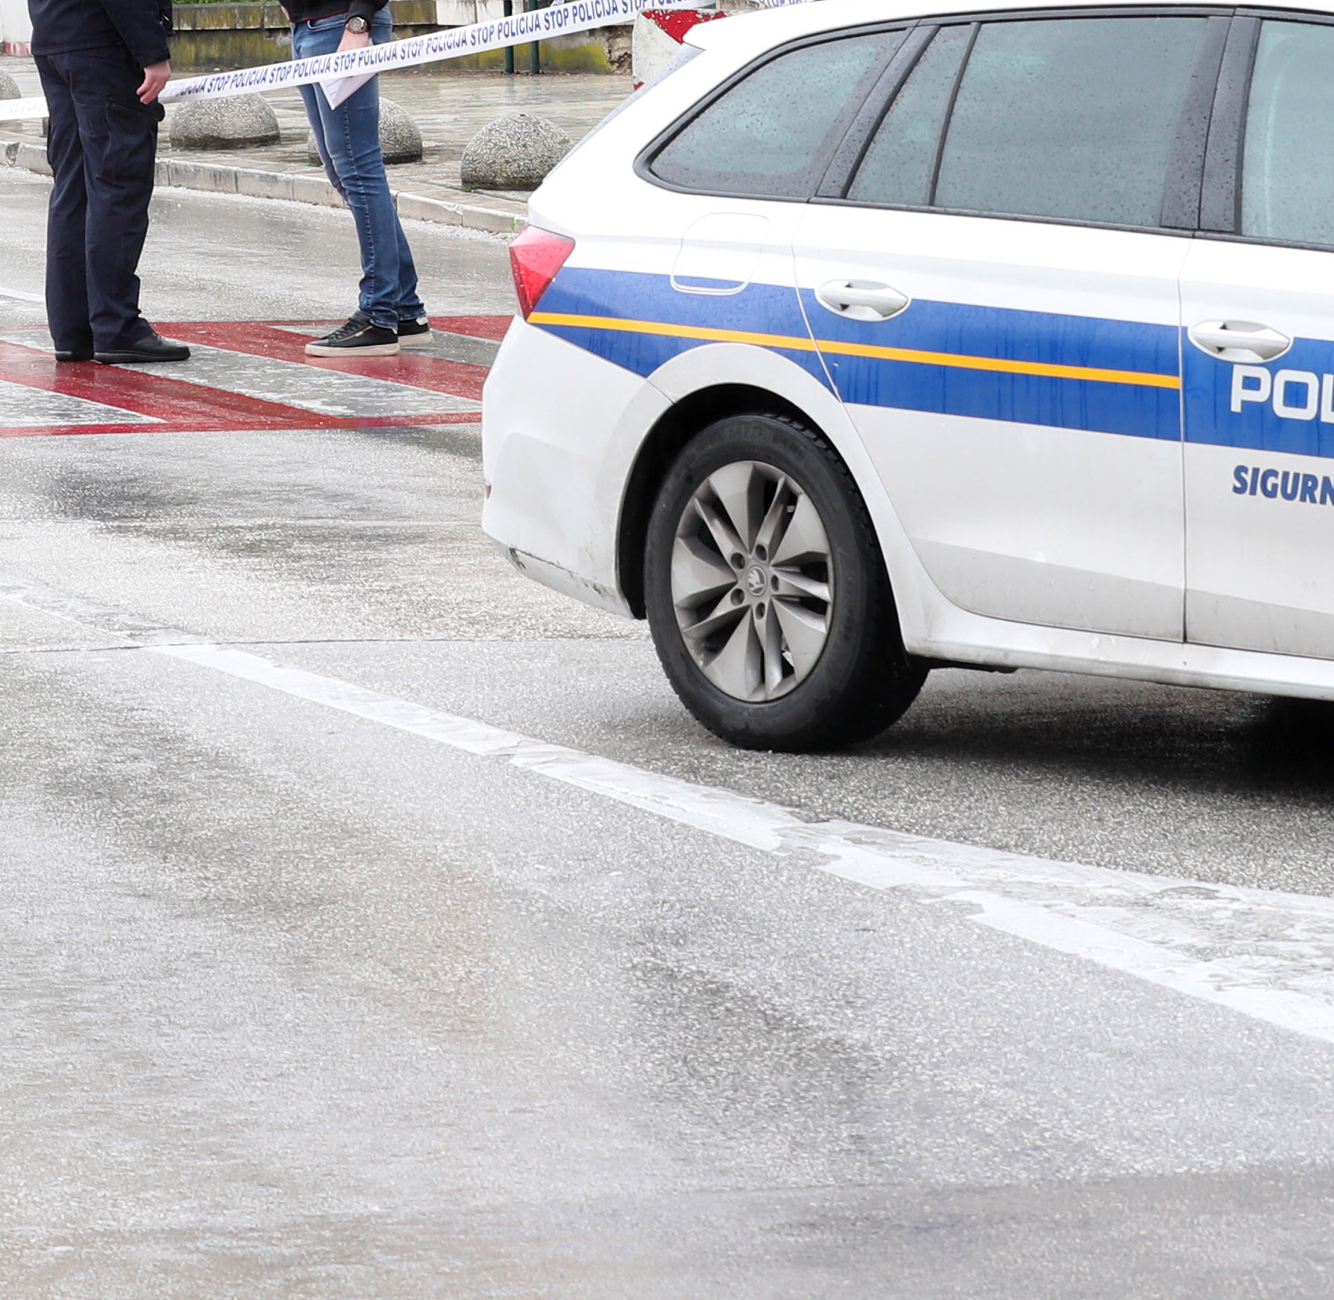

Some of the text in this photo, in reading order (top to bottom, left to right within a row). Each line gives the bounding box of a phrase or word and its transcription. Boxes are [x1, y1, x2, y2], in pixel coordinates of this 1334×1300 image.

[207, 74, 231, 93] STOP
[230, 69, 267, 88] POLICIJA
[269, 64, 291, 84] STOP
[292, 57, 331, 78] POLICIJA
[333, 54, 357, 73] STOP
[357, 43, 398, 66] POLICIJA
[400, 40, 424, 62] STOP
[425, 29, 468, 55] POLICIJA
[470, 23, 495, 46] STOP
[497, 14, 542, 41] POLICIJA
[544, 7, 569, 31] STOP
